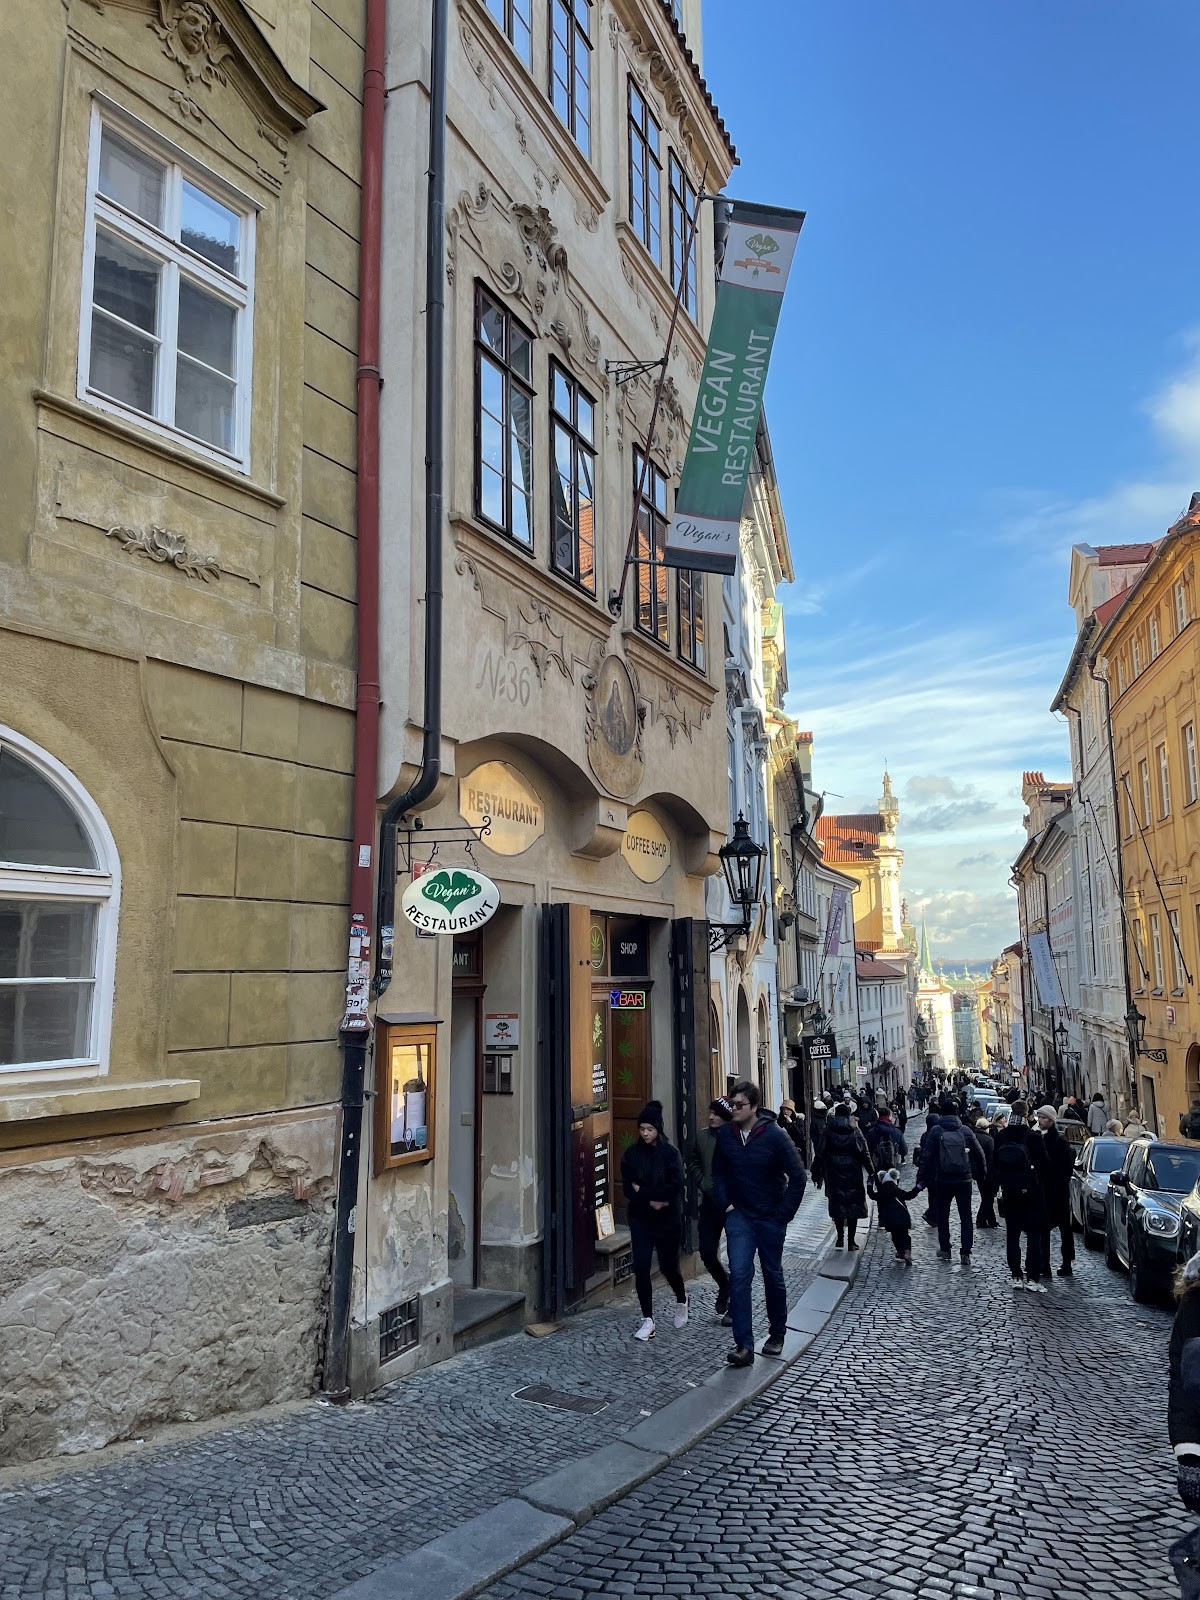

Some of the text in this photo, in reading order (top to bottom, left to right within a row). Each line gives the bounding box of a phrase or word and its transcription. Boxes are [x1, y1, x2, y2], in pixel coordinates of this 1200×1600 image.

[692, 348, 736, 453] VEGAN
[721, 329, 770, 485] RESTAURANT
[676, 521, 733, 545] Vegan's
[468, 788, 539, 826] RESTAURANT
[626, 834, 667, 857] COFFEE SHOP
[425, 883, 478, 902] Vegan's
[406, 900, 493, 930] RESTAURANT
[620, 942, 638, 955] SHOP
[619, 993, 643, 1006] BAR
[809, 1044, 831, 1054] COFFEE
